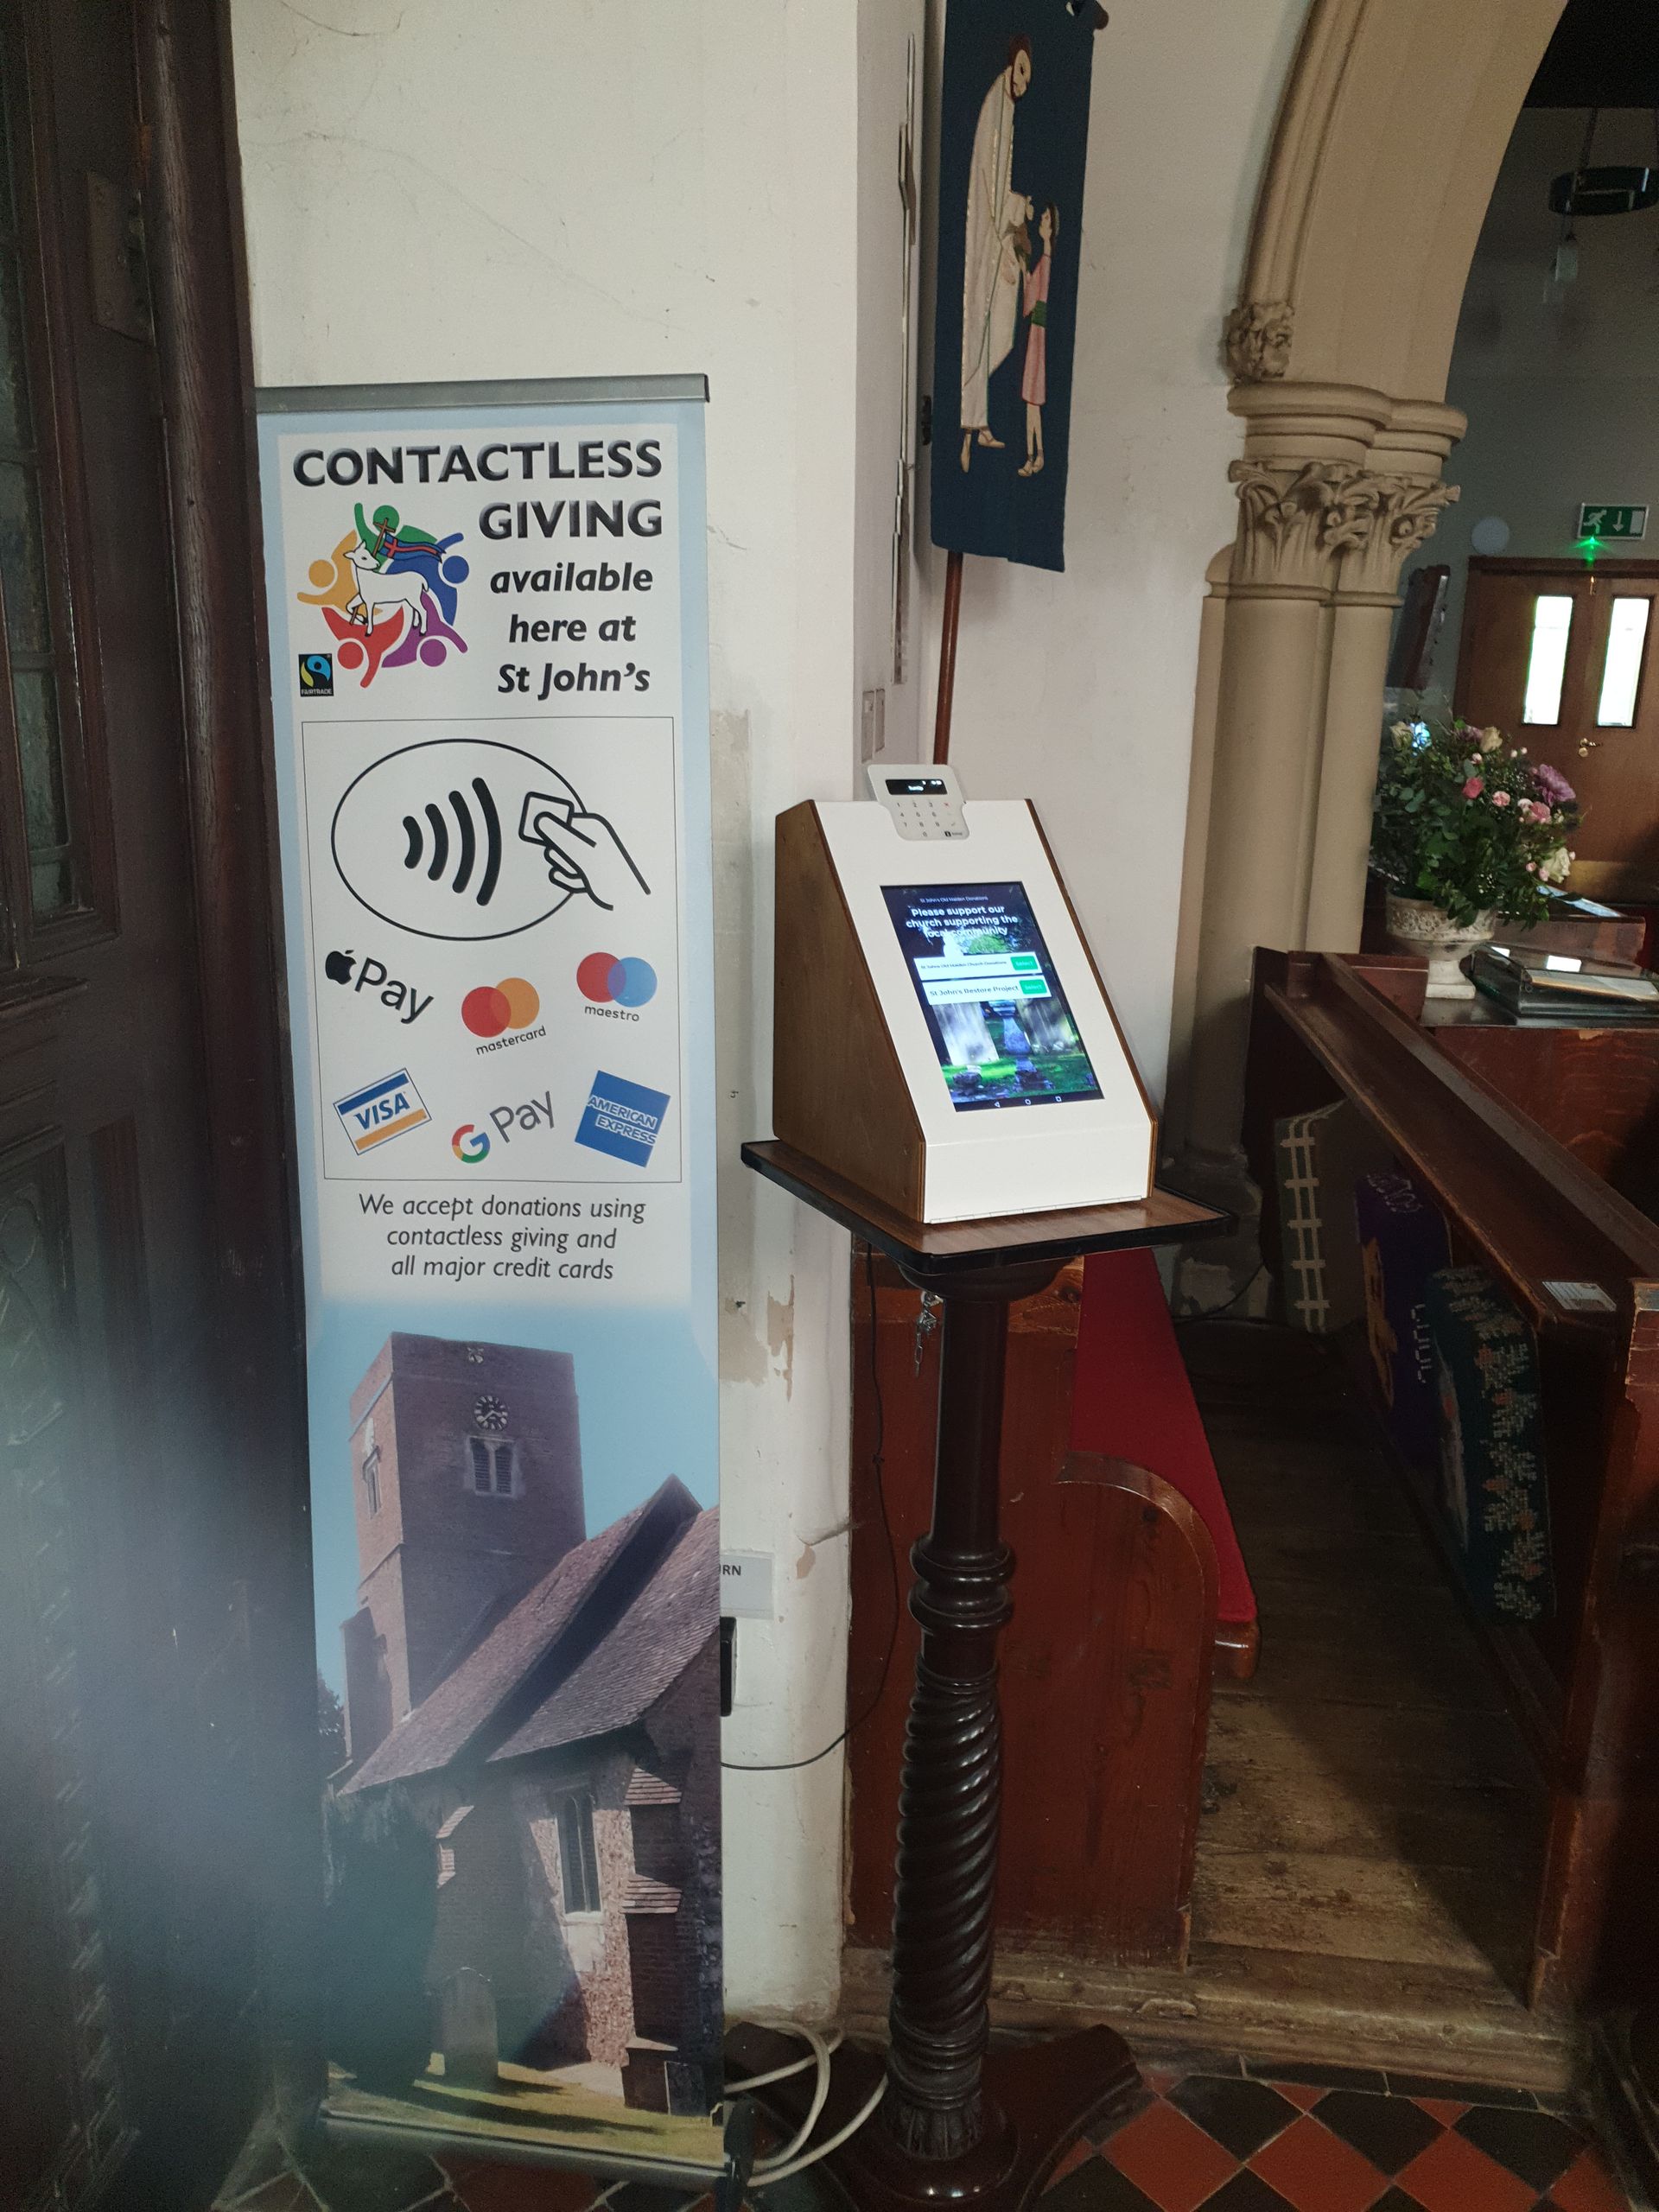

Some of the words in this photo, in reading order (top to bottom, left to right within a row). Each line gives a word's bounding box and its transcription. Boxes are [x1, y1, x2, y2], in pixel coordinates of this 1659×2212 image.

[293, 439, 663, 486] CONTACTLESS
[479, 499, 663, 540] GIVING
[491, 563, 653, 594] available
[509, 614, 587, 643] here
[598, 615, 636, 642] at
[498, 664, 530, 693] St
[537, 662, 651, 701] John’s
[906, 918, 942, 928] church
[944, 916, 1000, 927] supporting
[912, 908, 944, 917] Please
[947, 906, 987, 916] support
[950, 926, 1007, 937] community
[354, 957, 434, 1025] Pay
[584, 1003, 640, 1022] maestro
[476, 1026, 546, 1055] mastercard
[353, 1092, 410, 1130] VISA
[588, 1095, 656, 1129] AMERICAN
[451, 1124, 491, 1164] G
[490, 1090, 555, 1143] Pay
[596, 1114, 656, 1144] EXPRESS
[359, 1192, 394, 1215] We
[403, 1194, 474, 1221] accept
[481, 1194, 582, 1217] donations
[590, 1199, 645, 1224] using
[387, 1224, 503, 1246] contactless
[511, 1228, 569, 1254] giving
[576, 1229, 617, 1249] and
[391, 1255, 416, 1276] all
[423, 1256, 486, 1282] major
[493, 1257, 552, 1278] credit
[559, 1258, 614, 1280] cards
